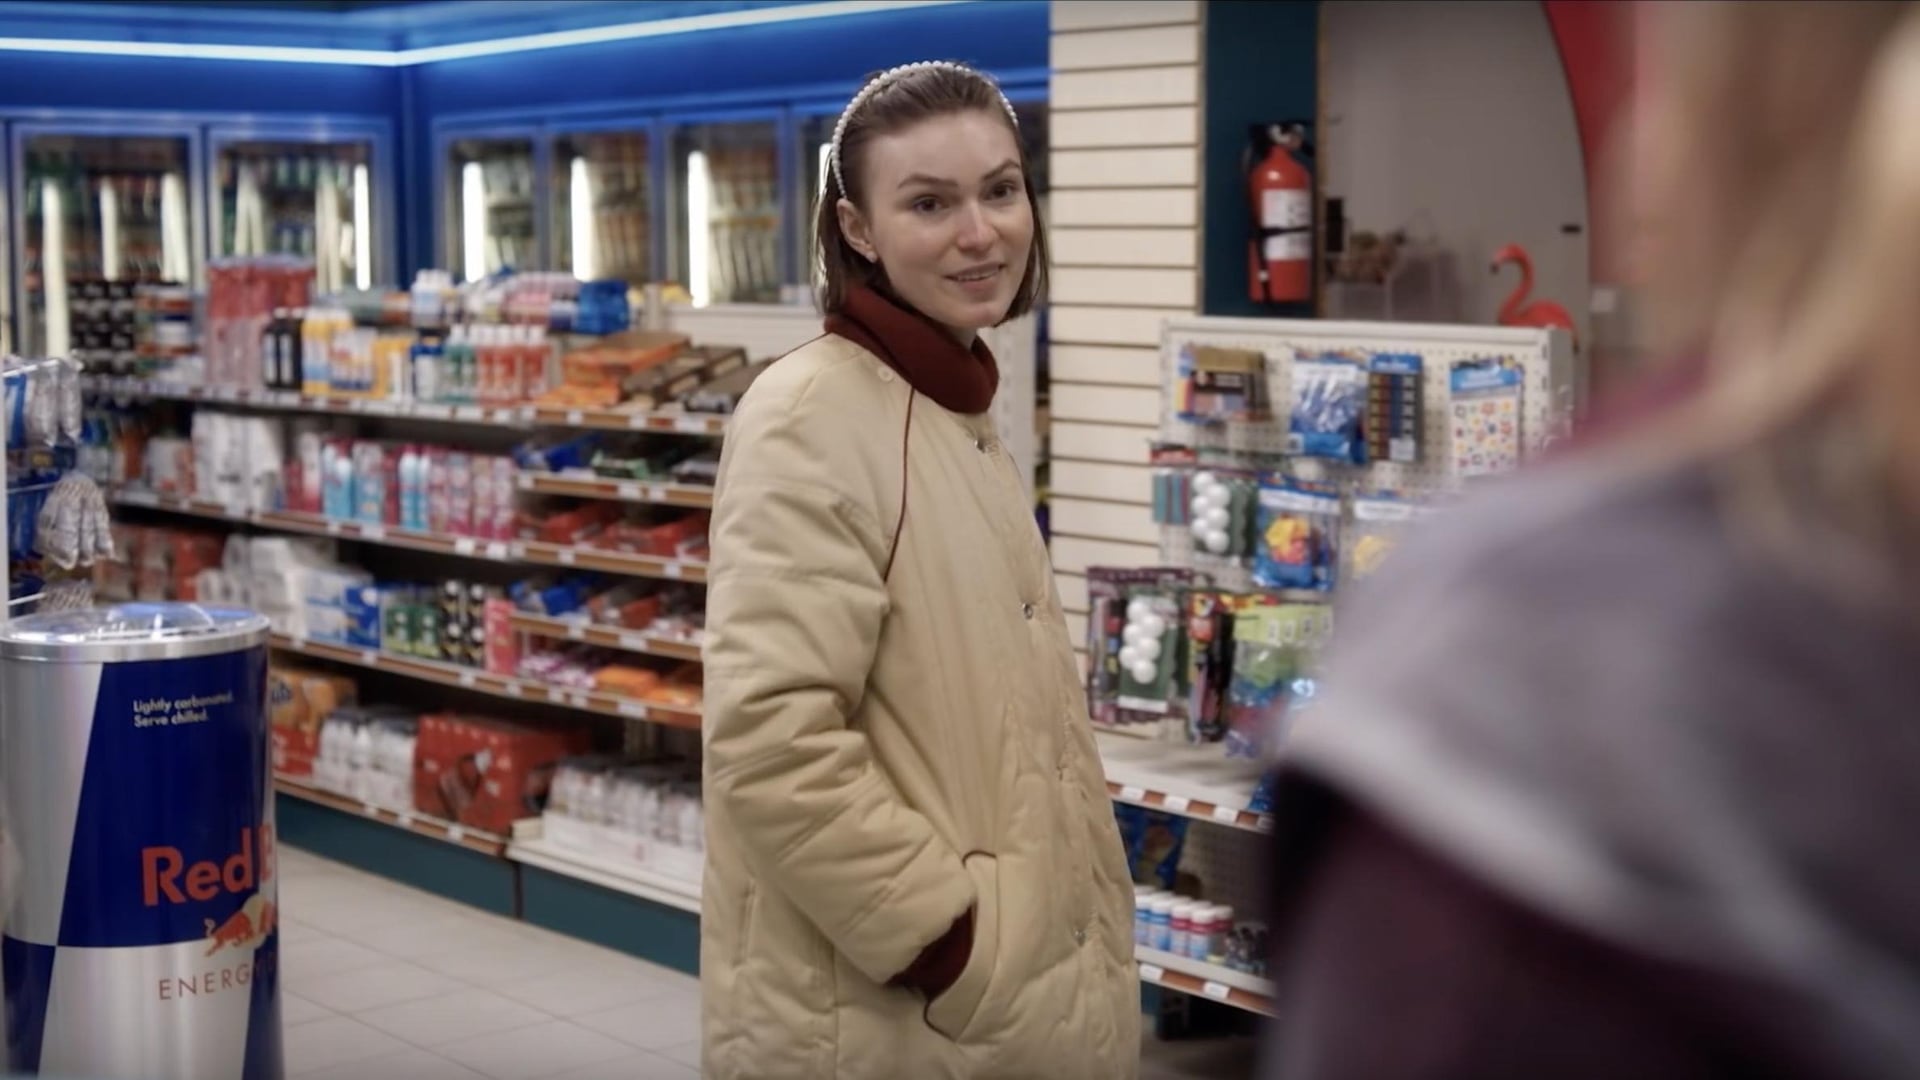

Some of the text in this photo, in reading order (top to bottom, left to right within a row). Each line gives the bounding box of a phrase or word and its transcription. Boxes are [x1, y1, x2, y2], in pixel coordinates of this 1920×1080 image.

[133, 698, 172, 715] Lightly
[133, 714, 169, 728] Serve
[142, 827, 253, 906] Red
